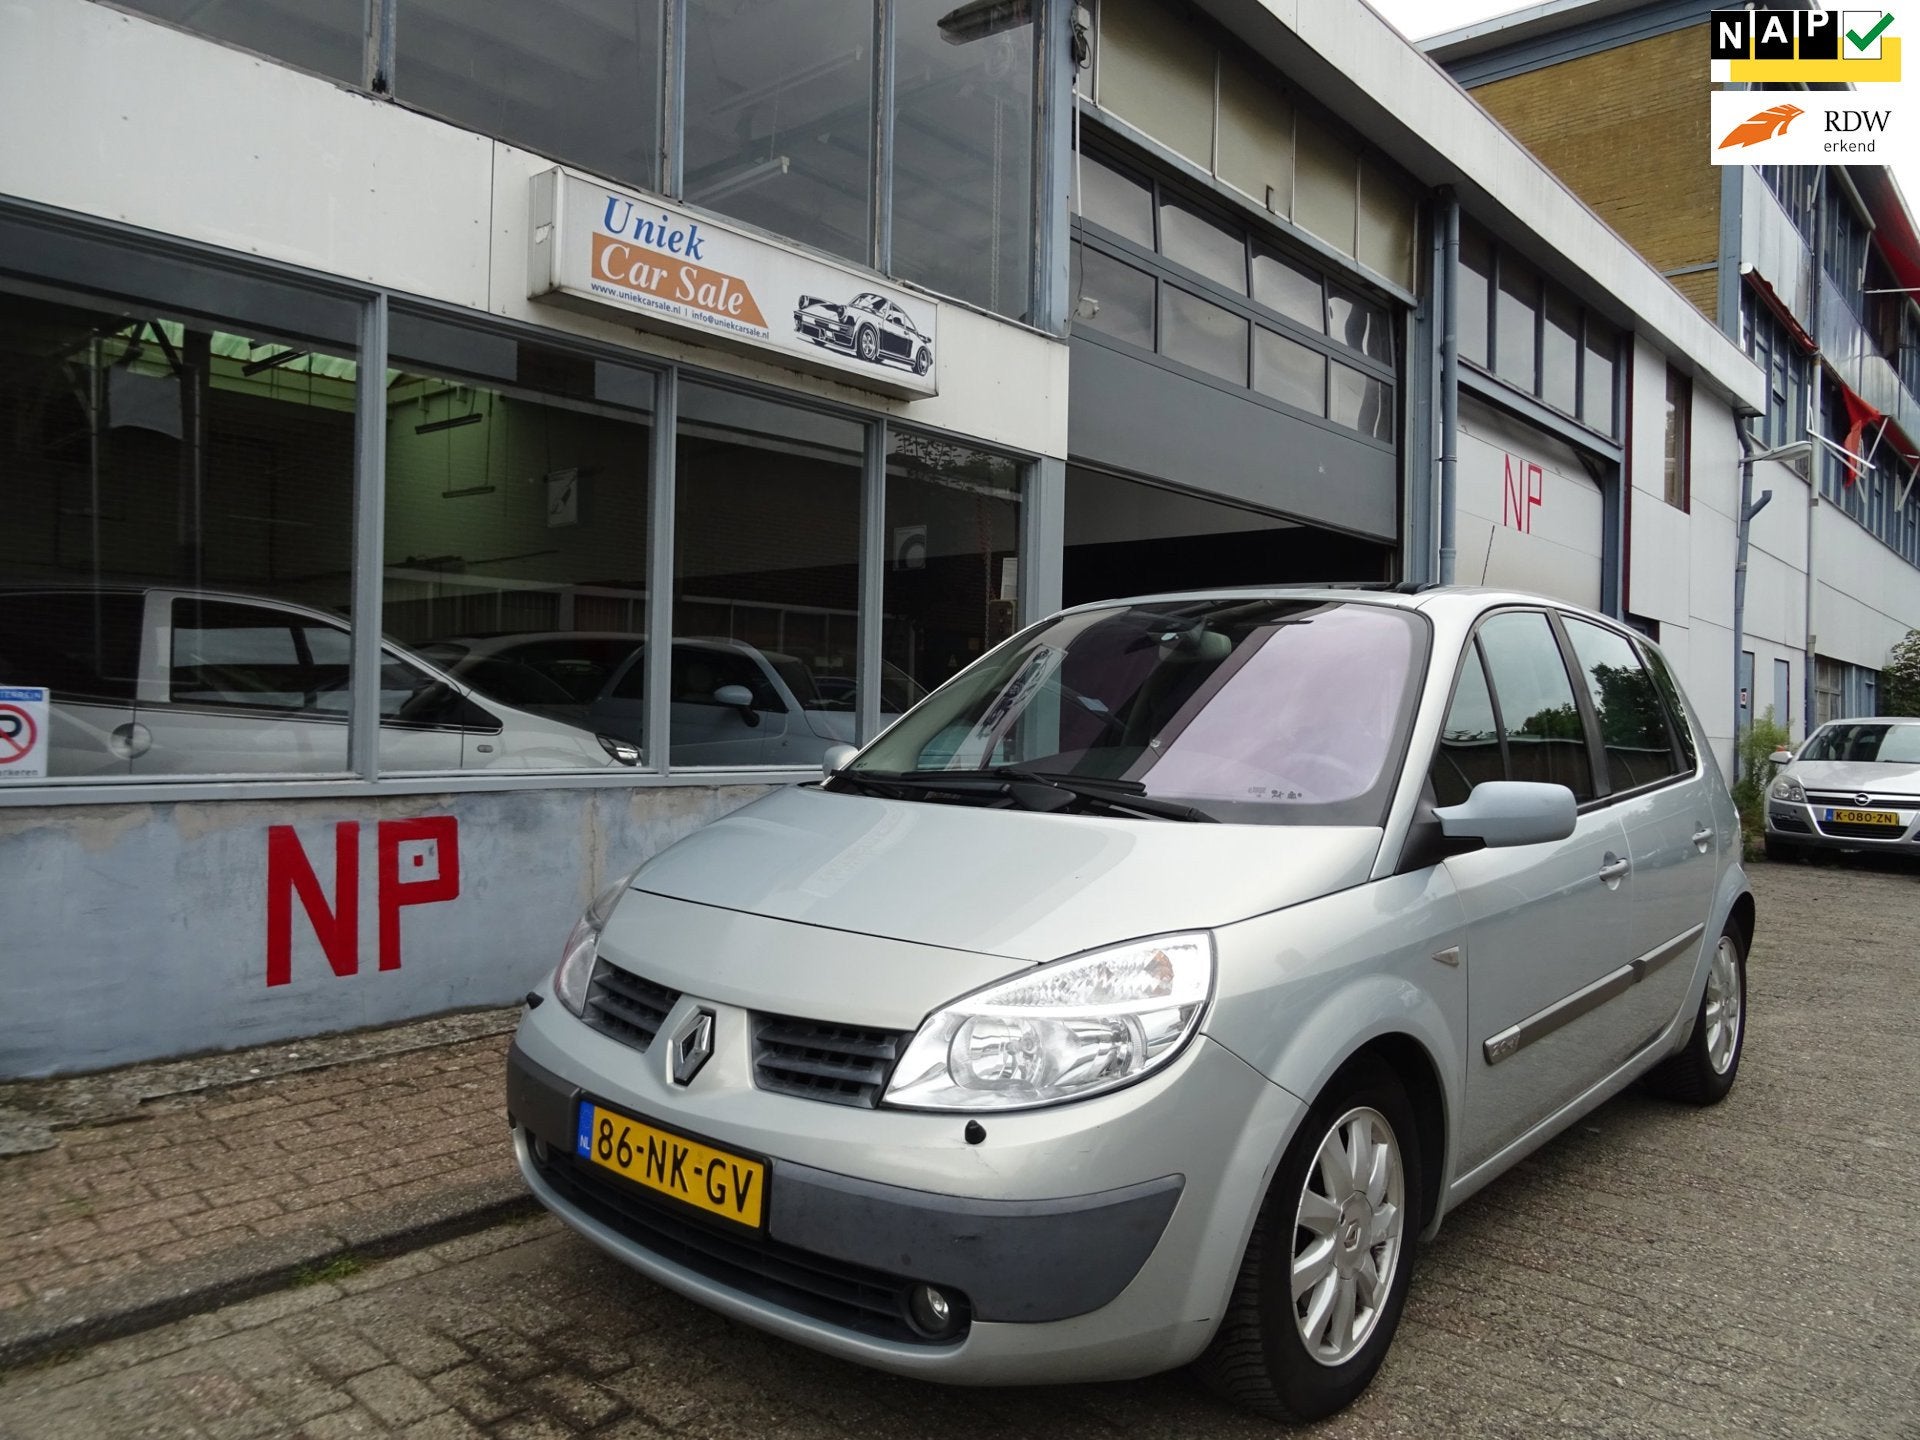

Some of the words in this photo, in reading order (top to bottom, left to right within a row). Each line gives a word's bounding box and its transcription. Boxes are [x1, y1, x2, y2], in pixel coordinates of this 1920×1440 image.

[603, 195, 705, 261] Uniek
[590, 282, 681, 314] www.uniekcarsale.nl
[691, 309, 770, 340] info@uniekcarsale.nl
[600, 243, 668, 291] Car
[675, 265, 744, 315] Sale
[1503, 453, 1543, 534] NP
[1835, 811, 1893, 824] K-080-ZN
[266, 815, 460, 987] NP
[579, 1134, 591, 1151] NL
[597, 1117, 754, 1214] 86-NK-GV
